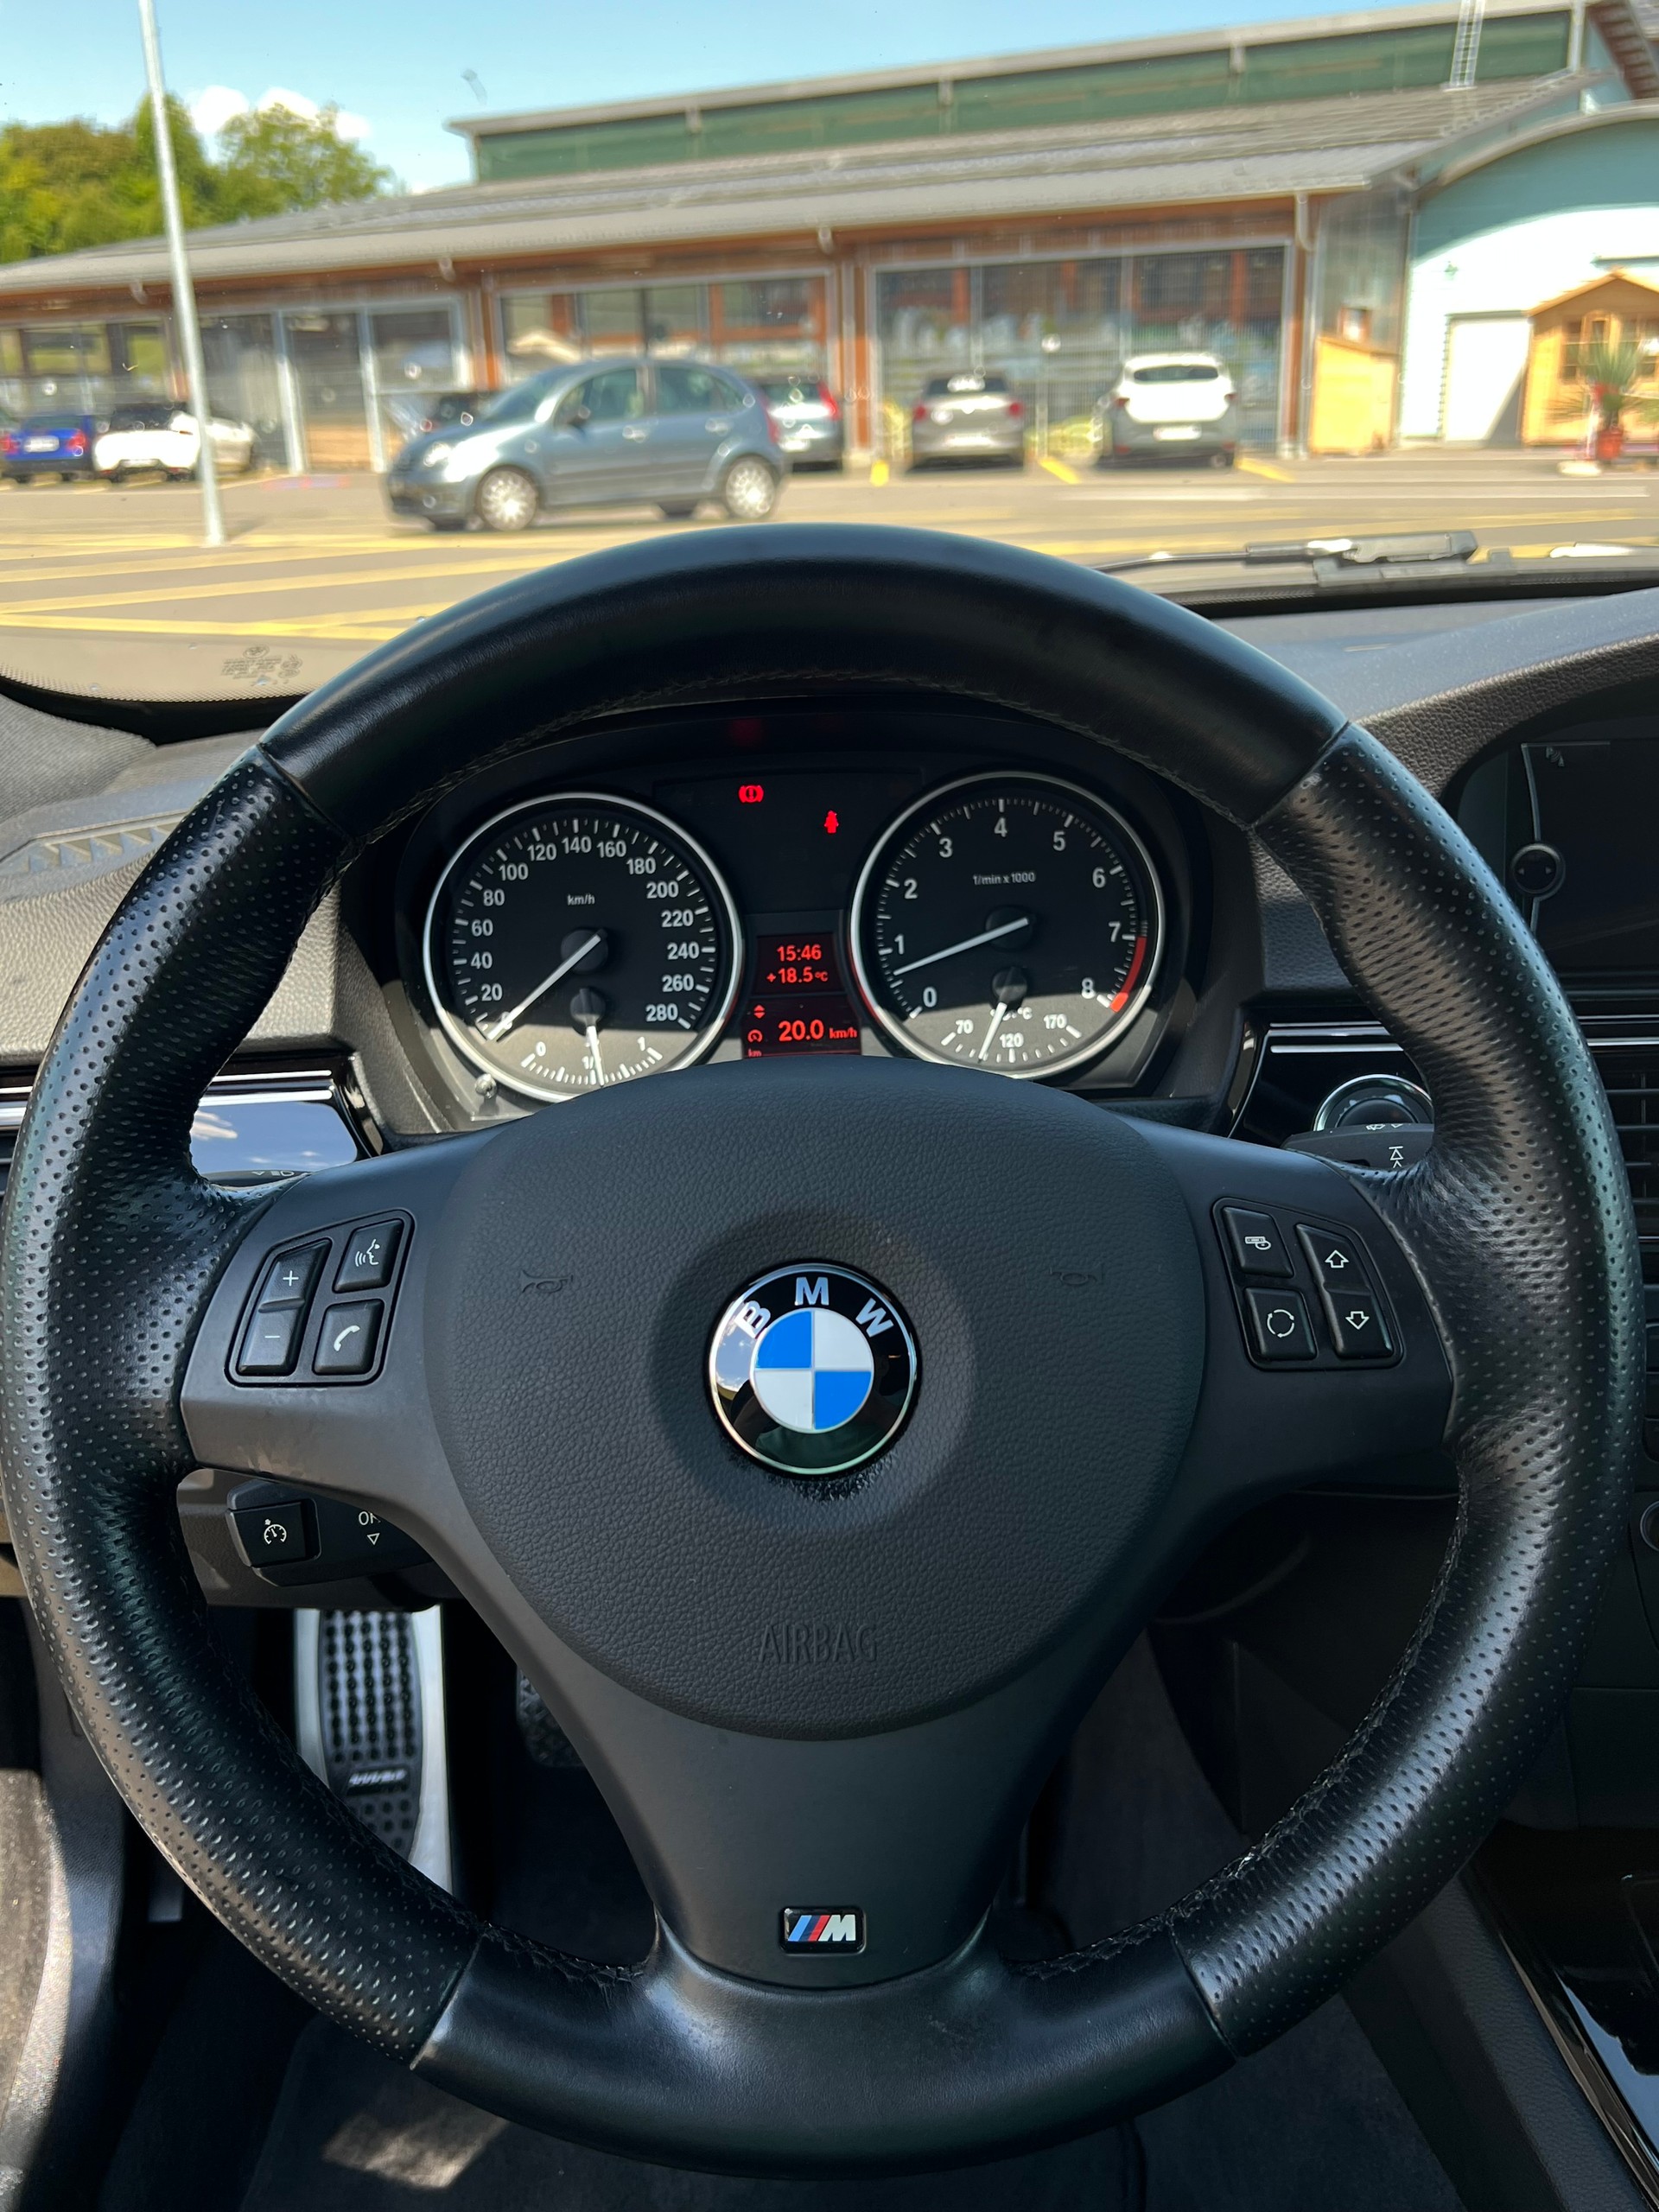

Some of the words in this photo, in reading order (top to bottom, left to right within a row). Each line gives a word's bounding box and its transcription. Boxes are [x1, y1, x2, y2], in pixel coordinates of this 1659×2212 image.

[995, 817, 1007, 837] 4
[562, 836, 592, 854] 140
[597, 841, 627, 858] 160
[938, 838, 953, 858] 3
[1052, 830, 1066, 851] 5
[527, 843, 557, 861] 120
[499, 864, 529, 881] 100
[626, 858, 657, 875] 180
[1011, 872, 1036, 883] 1000
[1092, 868, 1106, 888] 6
[483, 889, 505, 906] 80
[646, 881, 679, 899] 200
[904, 879, 918, 899] 2
[567, 893, 595, 906] km/h
[471, 919, 493, 936] 60
[660, 910, 694, 927] 220
[1108, 922, 1122, 942] 7
[667, 943, 700, 960] 240
[777, 944, 822, 962] 15:46
[894, 934, 905, 955] 1
[471, 952, 493, 969] 40
[480, 983, 503, 1001] 20
[662, 975, 695, 992] 260
[1081, 978, 1095, 999] 8
[923, 987, 938, 1007] 0
[645, 1004, 678, 1022] 280
[1043, 1014, 1066, 1029] 170
[778, 1019, 824, 1042] 20.0
[829, 1027, 858, 1039] km/h
[956, 1020, 974, 1034] 70
[536, 1041, 546, 1057] 0
[637, 1036, 645, 1052] 1
[999, 1032, 1024, 1048] 120
[747, 1049, 762, 1058] km
[734, 1276, 894, 1338] BMW
[758, 1624, 878, 1663] AIRBAG
